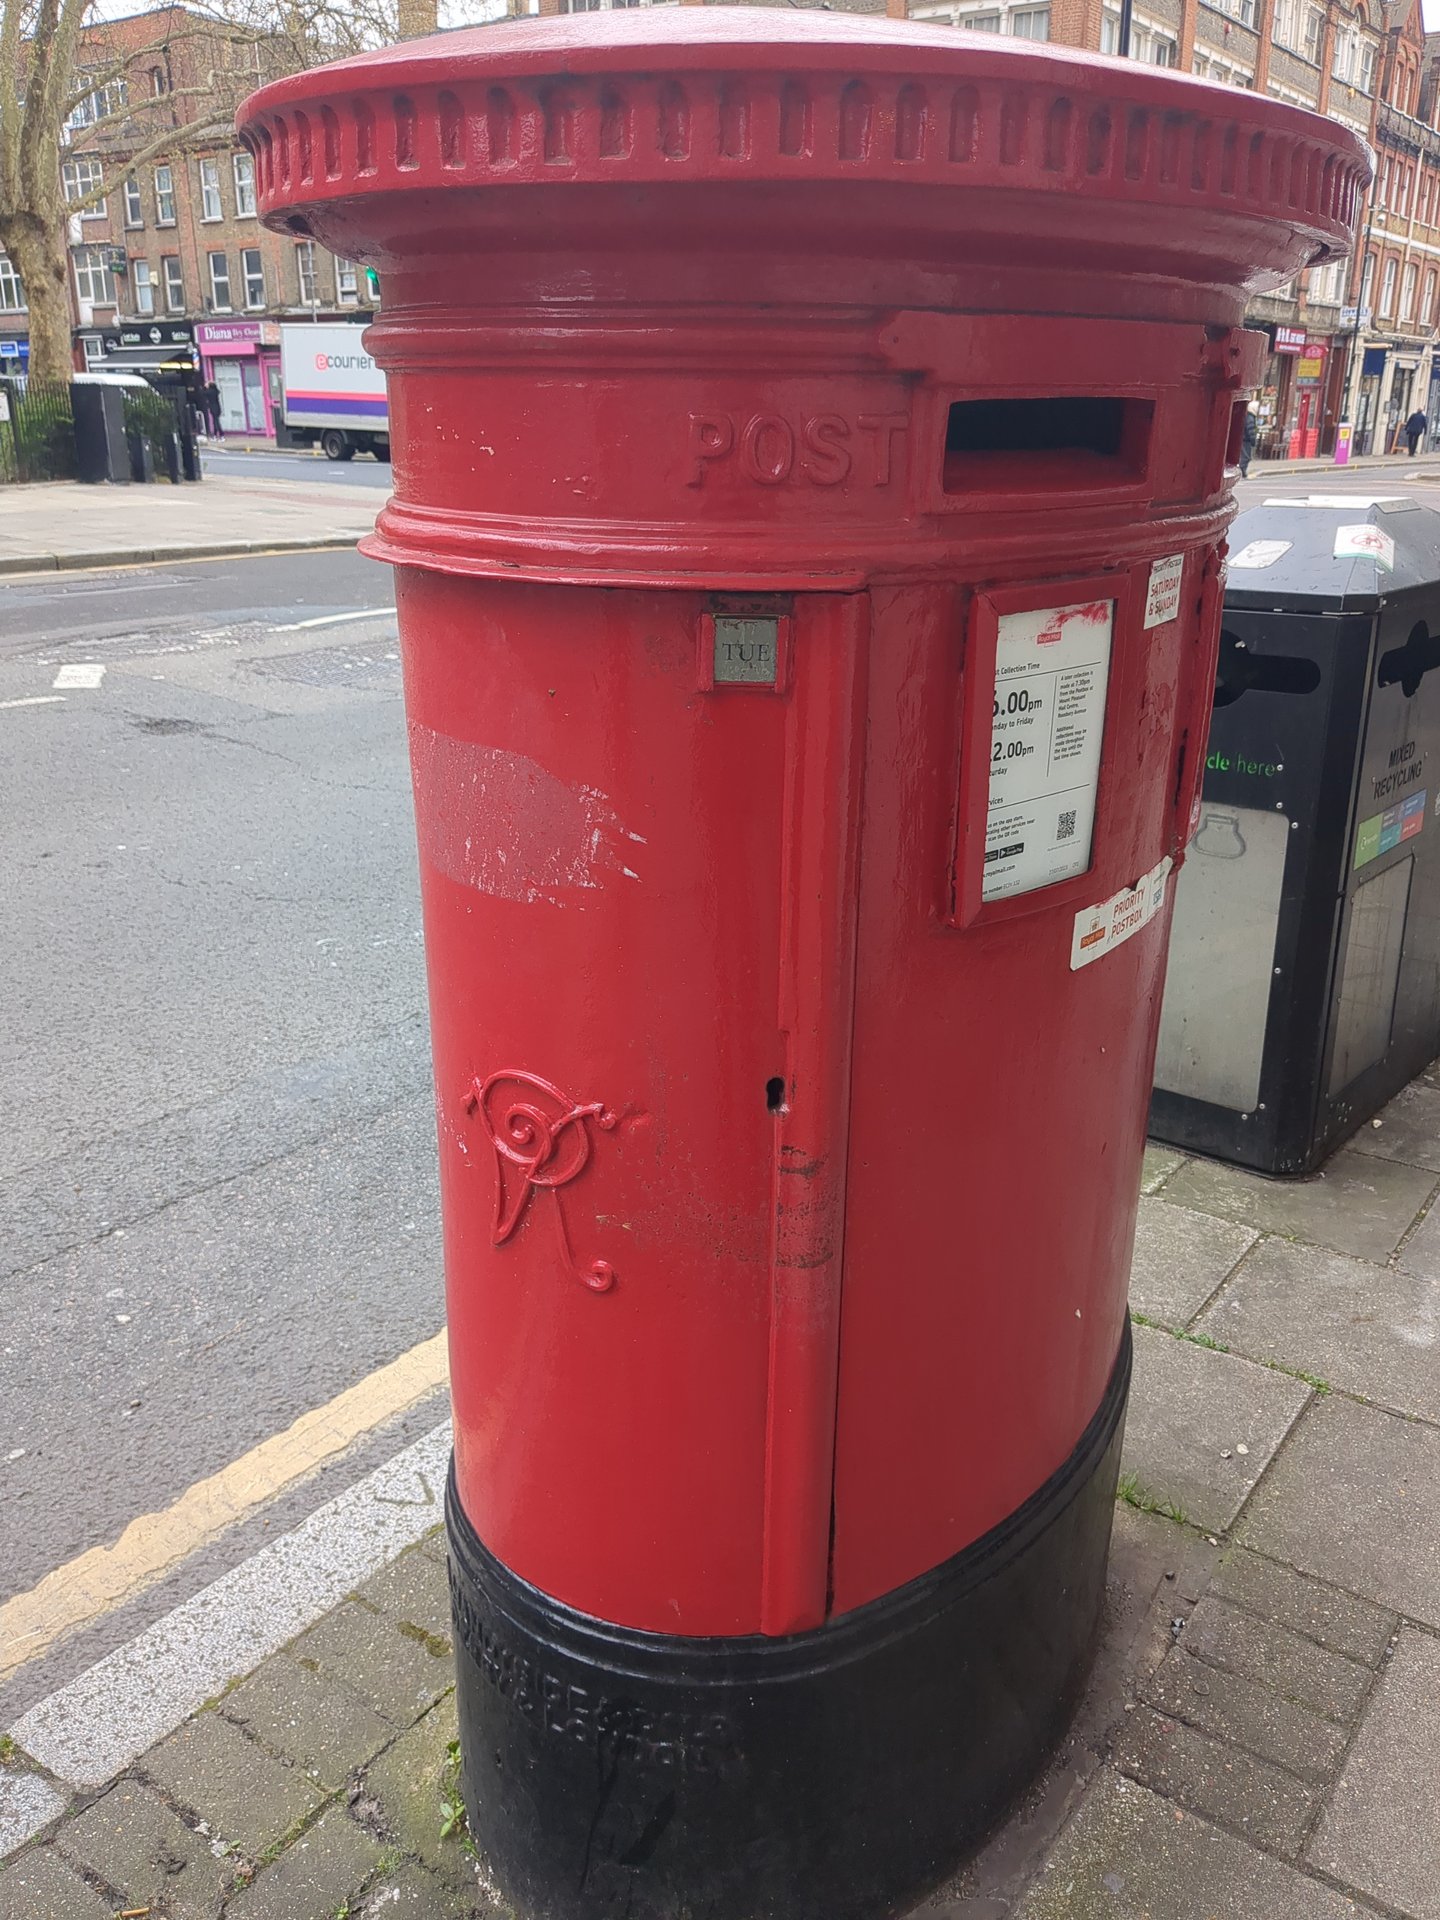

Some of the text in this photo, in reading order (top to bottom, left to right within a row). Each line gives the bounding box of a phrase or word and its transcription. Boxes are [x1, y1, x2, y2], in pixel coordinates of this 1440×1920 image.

[204, 326, 233, 340] Diana
[316, 353, 374, 370] ecourier
[686, 410, 910, 490] POST
[1150, 575, 1180, 597] SATURDAY
[1148, 594, 1178, 616] & SUNDAY
[721, 643, 770, 662] TUE
[1001, 664, 1026, 675] Collection
[1027, 662, 1040, 670] Time
[1009, 720, 1015, 728] to
[1016, 717, 1034, 727] Friday
[989, 741, 1034, 763] 2.00pm
[1388, 740, 1416, 769] MIXED
[1236, 751, 1275, 777] here
[1373, 760, 1422, 801] RECYCLING
[989, 796, 1004, 806] vices
[1113, 886, 1145, 918] PRIORITY
[1110, 906, 1144, 939] POSTBOX
[1081, 928, 1106, 946] Royal Mail
